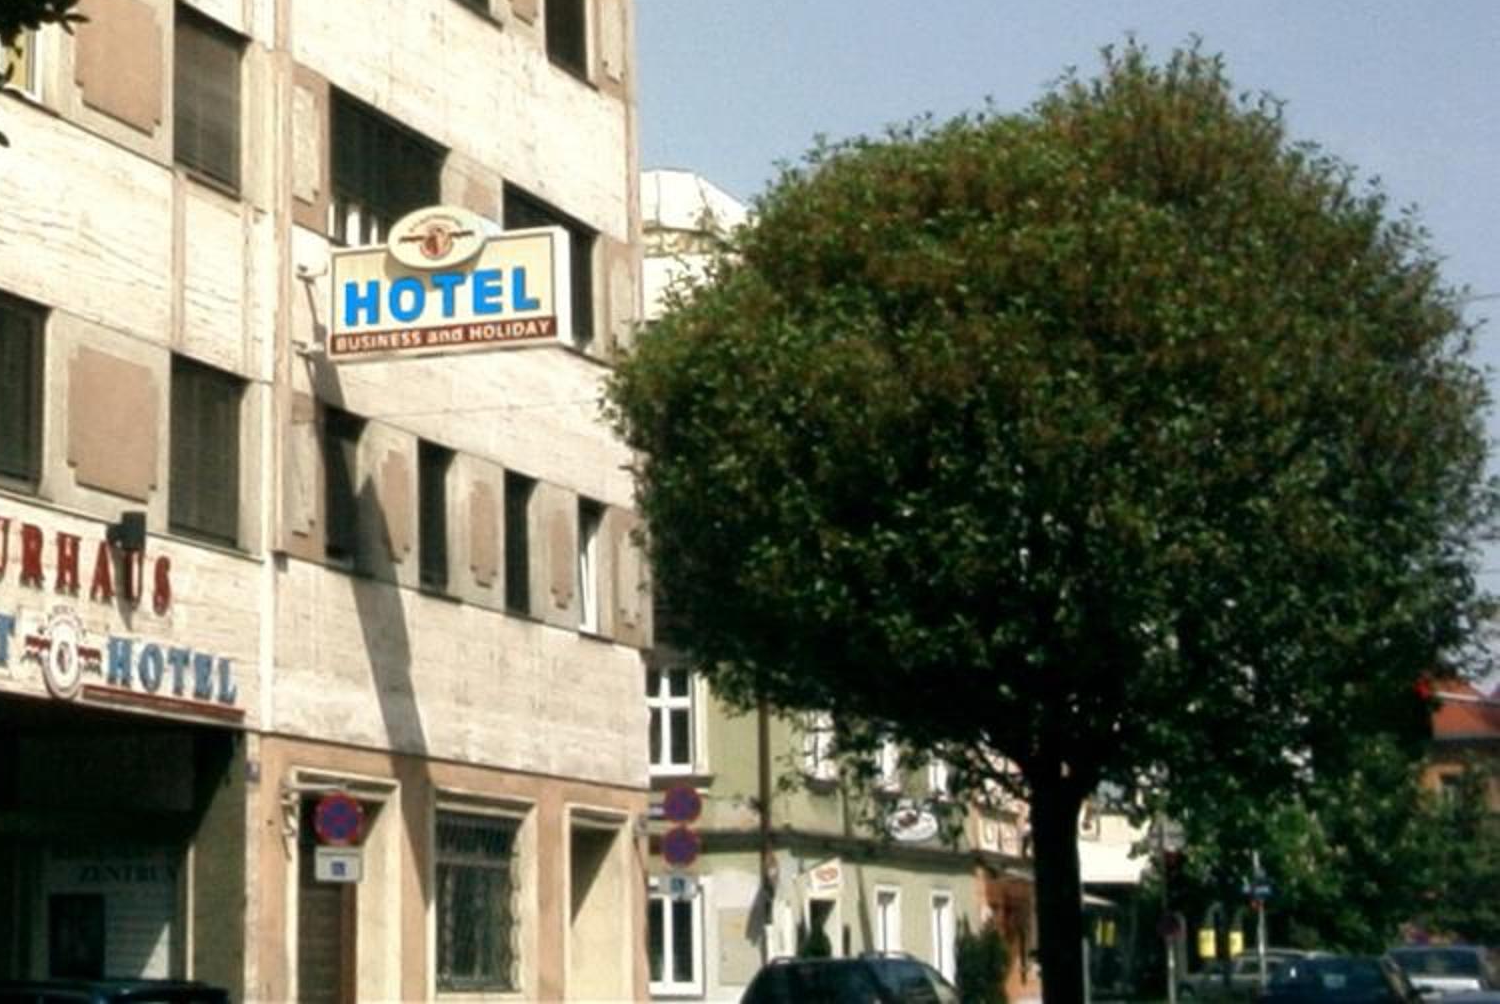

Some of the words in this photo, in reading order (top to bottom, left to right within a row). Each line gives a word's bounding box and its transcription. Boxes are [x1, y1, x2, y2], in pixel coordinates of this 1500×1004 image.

[344, 266, 539, 327] HOTEL
[335, 330, 422, 351] BUSINESS
[427, 327, 464, 344] and
[469, 321, 550, 339] HOLIDAY
[108, 637, 236, 704] HOTEL
